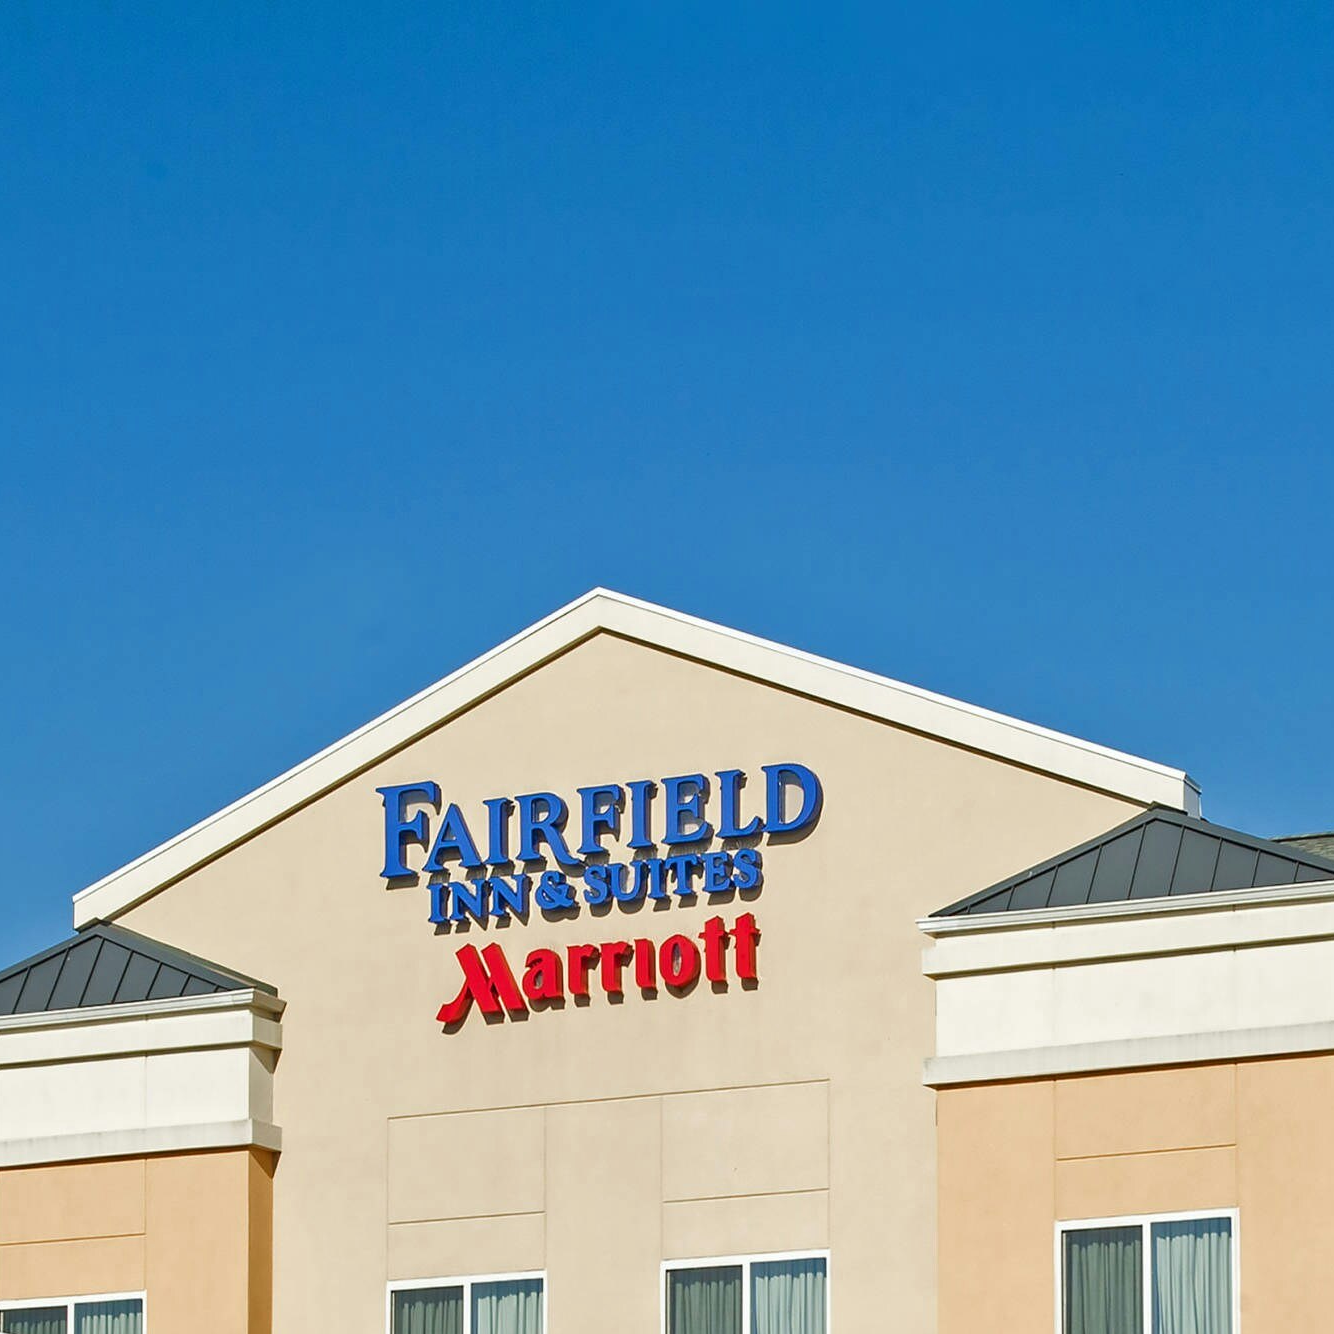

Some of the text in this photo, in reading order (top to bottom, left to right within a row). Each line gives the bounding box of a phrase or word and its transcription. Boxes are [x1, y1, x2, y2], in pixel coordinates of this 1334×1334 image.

[375, 763, 824, 878] FAIRFIELD
[427, 848, 763, 924] INN & SUITES
[435, 912, 761, 1025] Marriott
